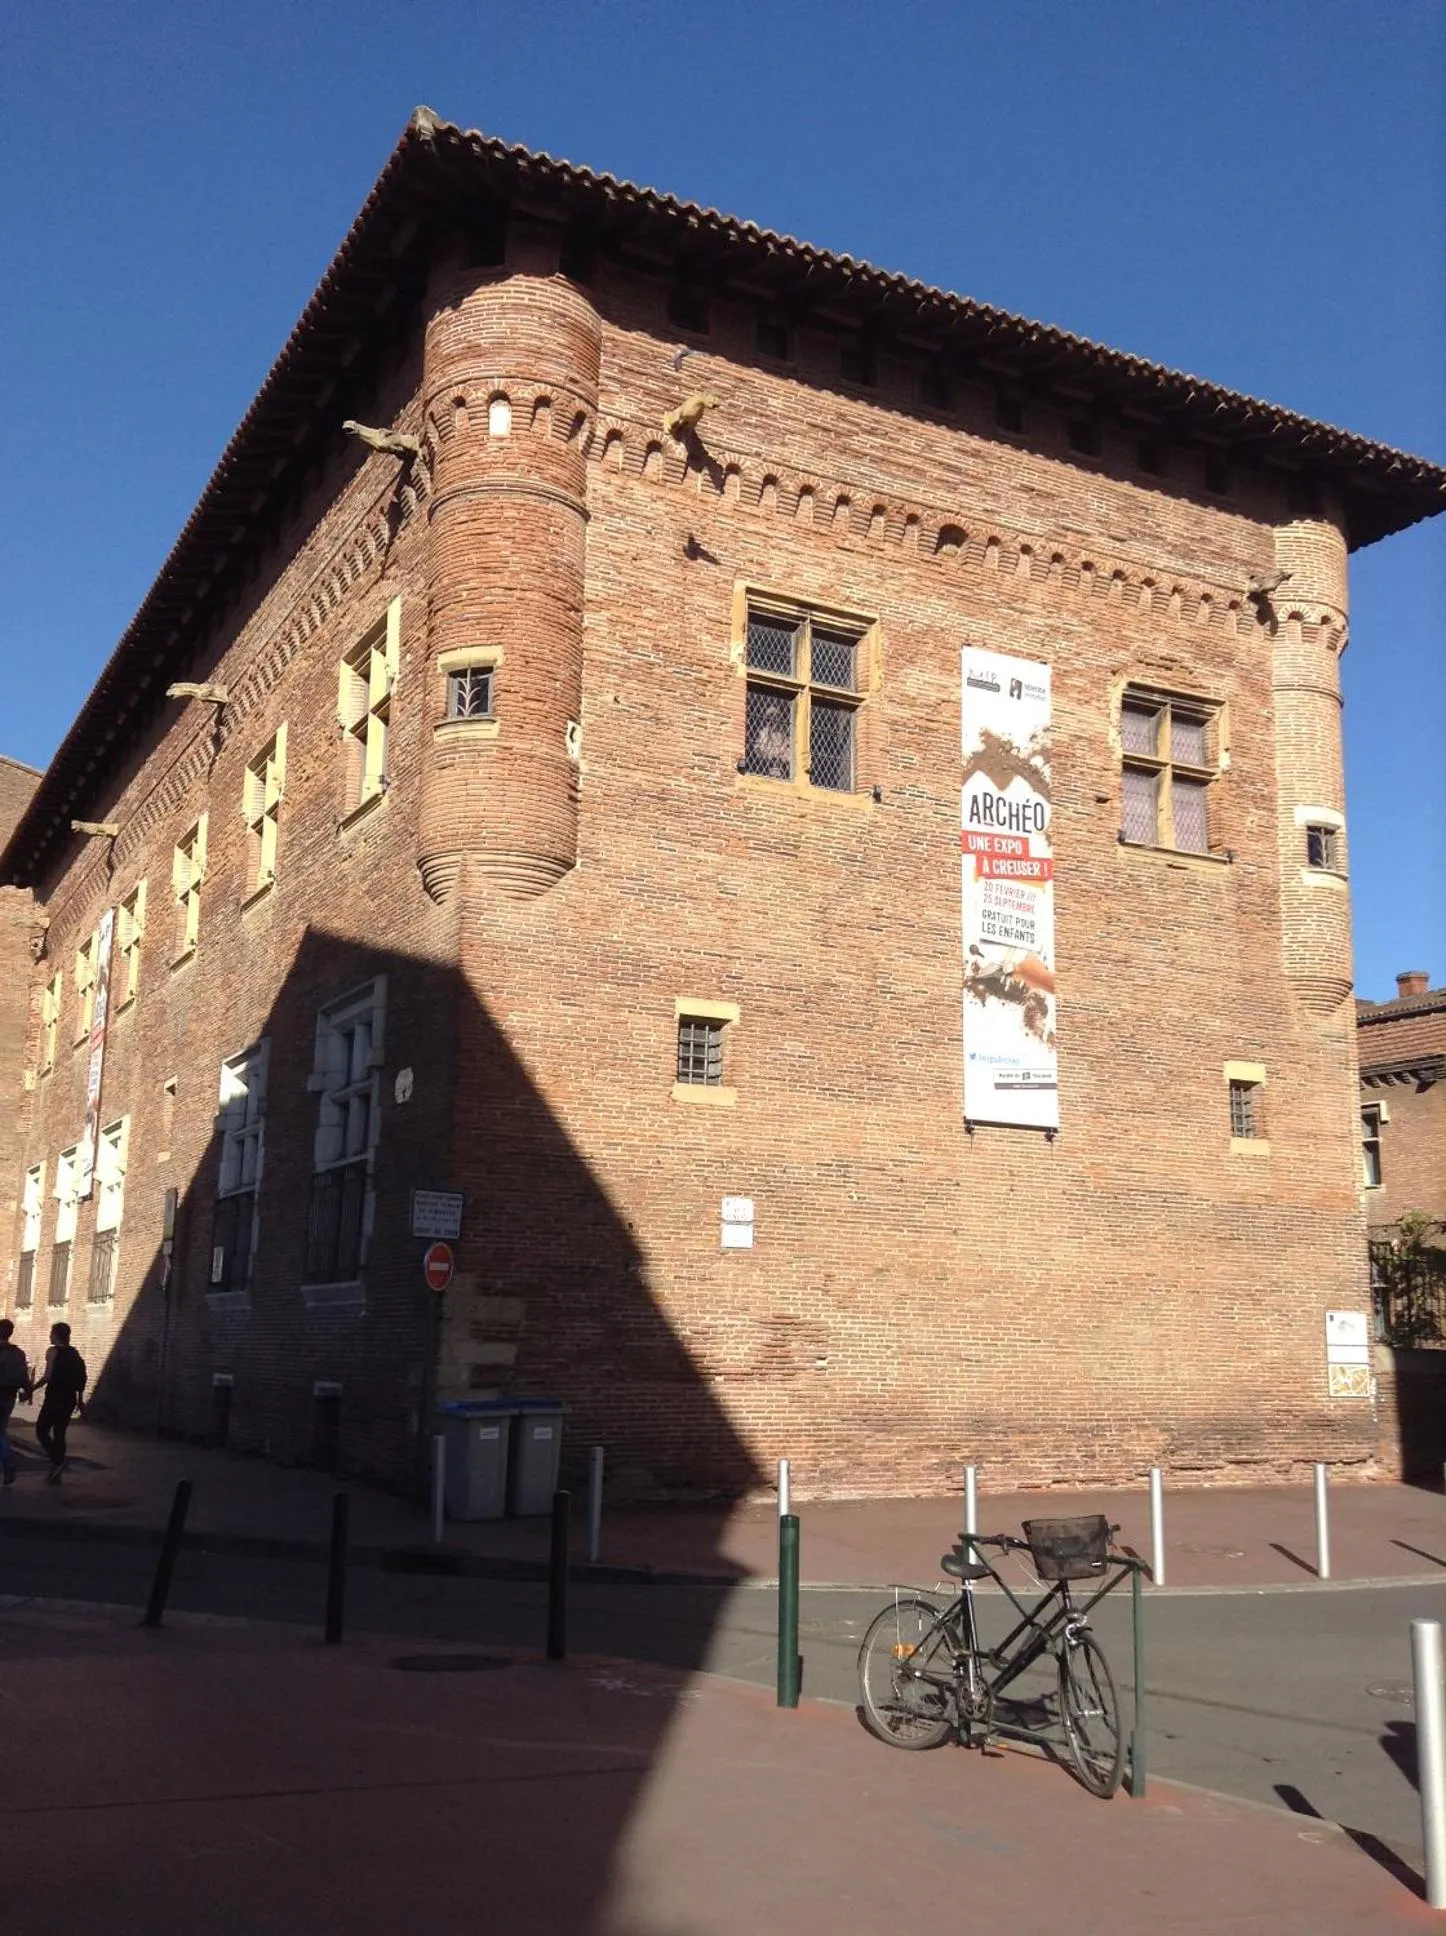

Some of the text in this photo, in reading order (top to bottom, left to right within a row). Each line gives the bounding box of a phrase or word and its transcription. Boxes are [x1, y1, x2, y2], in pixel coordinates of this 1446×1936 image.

[969, 792, 1045, 833] ARCHÉO
[968, 835, 1022, 854] UNE EXPO
[982, 855, 990, 873] À
[992, 858, 1040, 877] CREUSER
[994, 895, 1036, 914] SEPTEMBRE
[982, 909, 1035, 930] GRATUIT POUR
[981, 921, 1035, 944] LES ENFANTS
